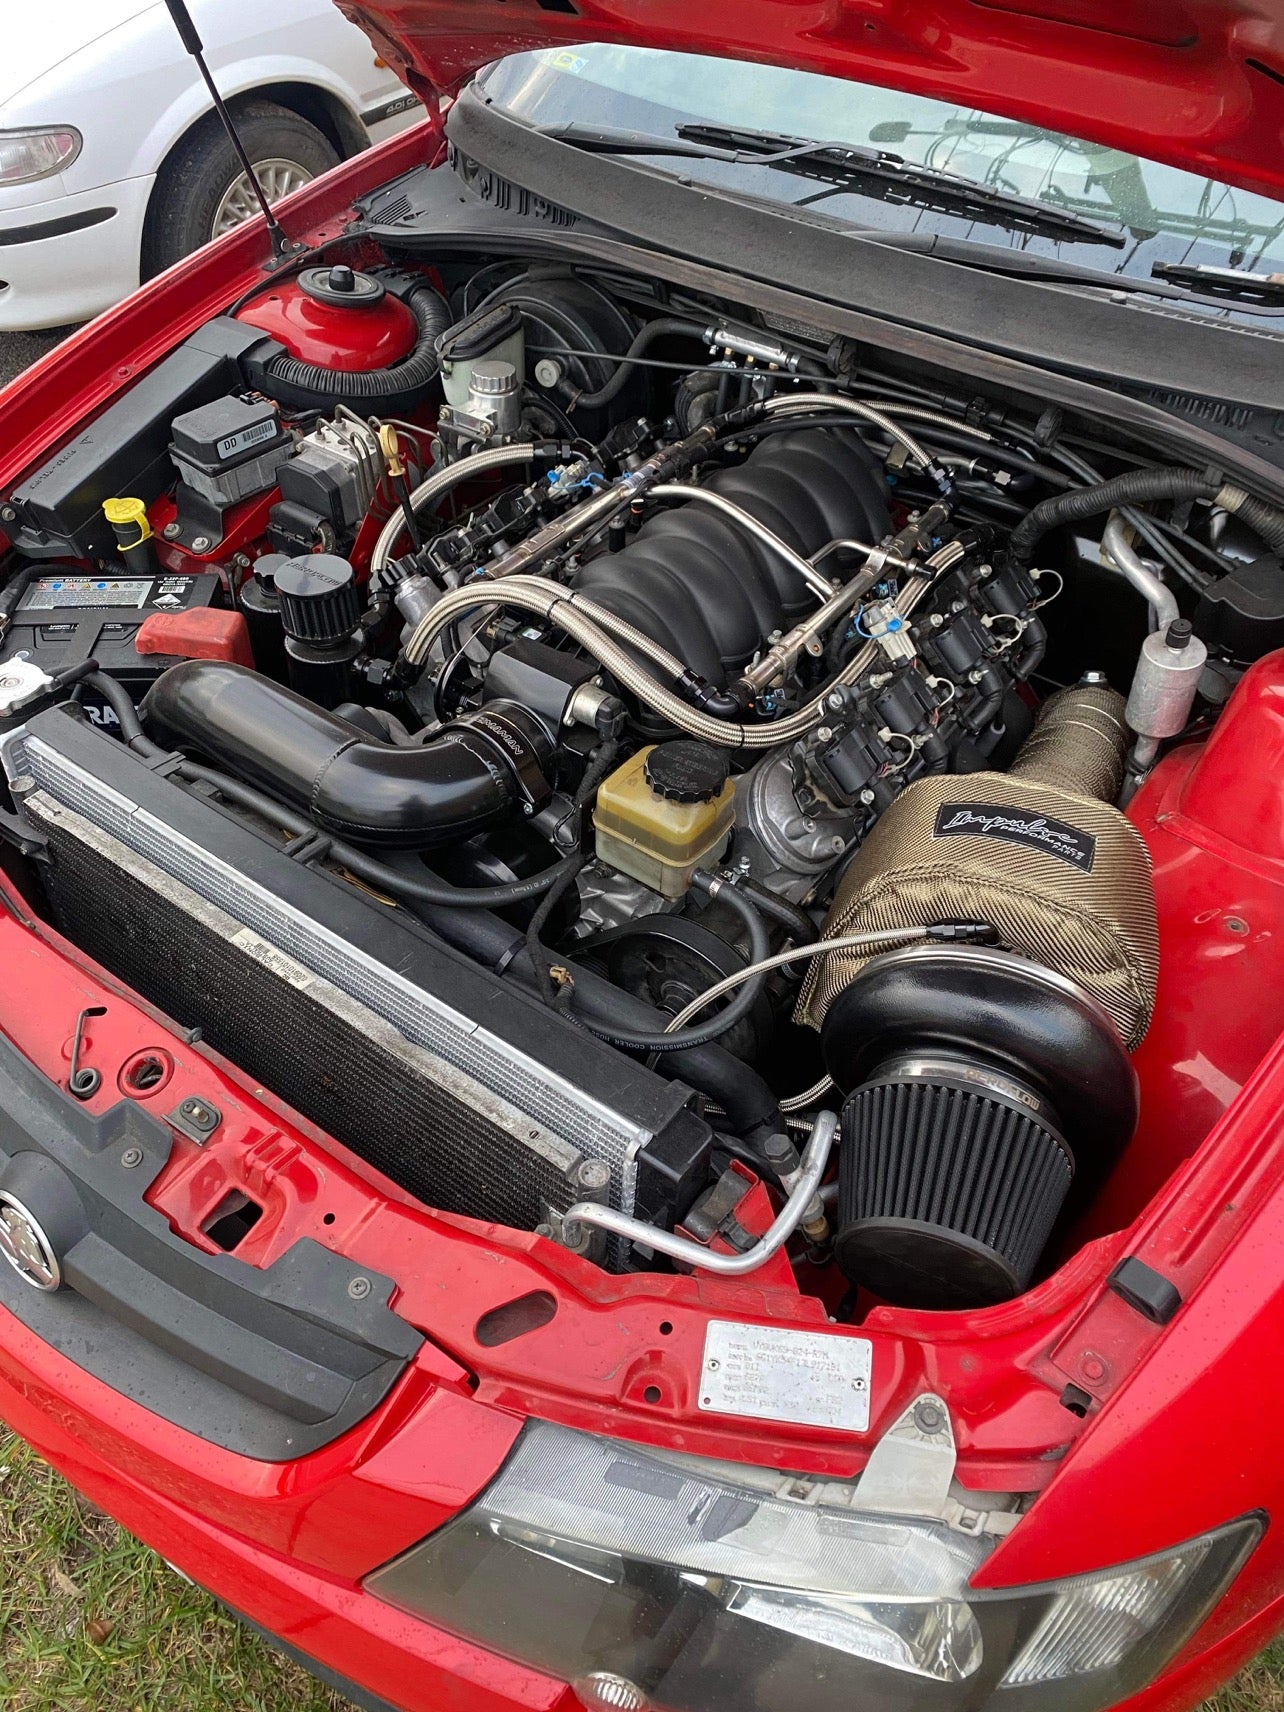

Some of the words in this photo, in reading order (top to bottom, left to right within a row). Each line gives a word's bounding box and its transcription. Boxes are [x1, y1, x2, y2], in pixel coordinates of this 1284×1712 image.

[223, 437, 237, 451] DD
[942, 810, 1079, 844] Impulse
[999, 825, 1086, 858] PERFORMANCE
[1051, 844, 1083, 861] PARTS
[614, 1038, 646, 1050] COOLER
[650, 1036, 709, 1051] TRANSMISSION
